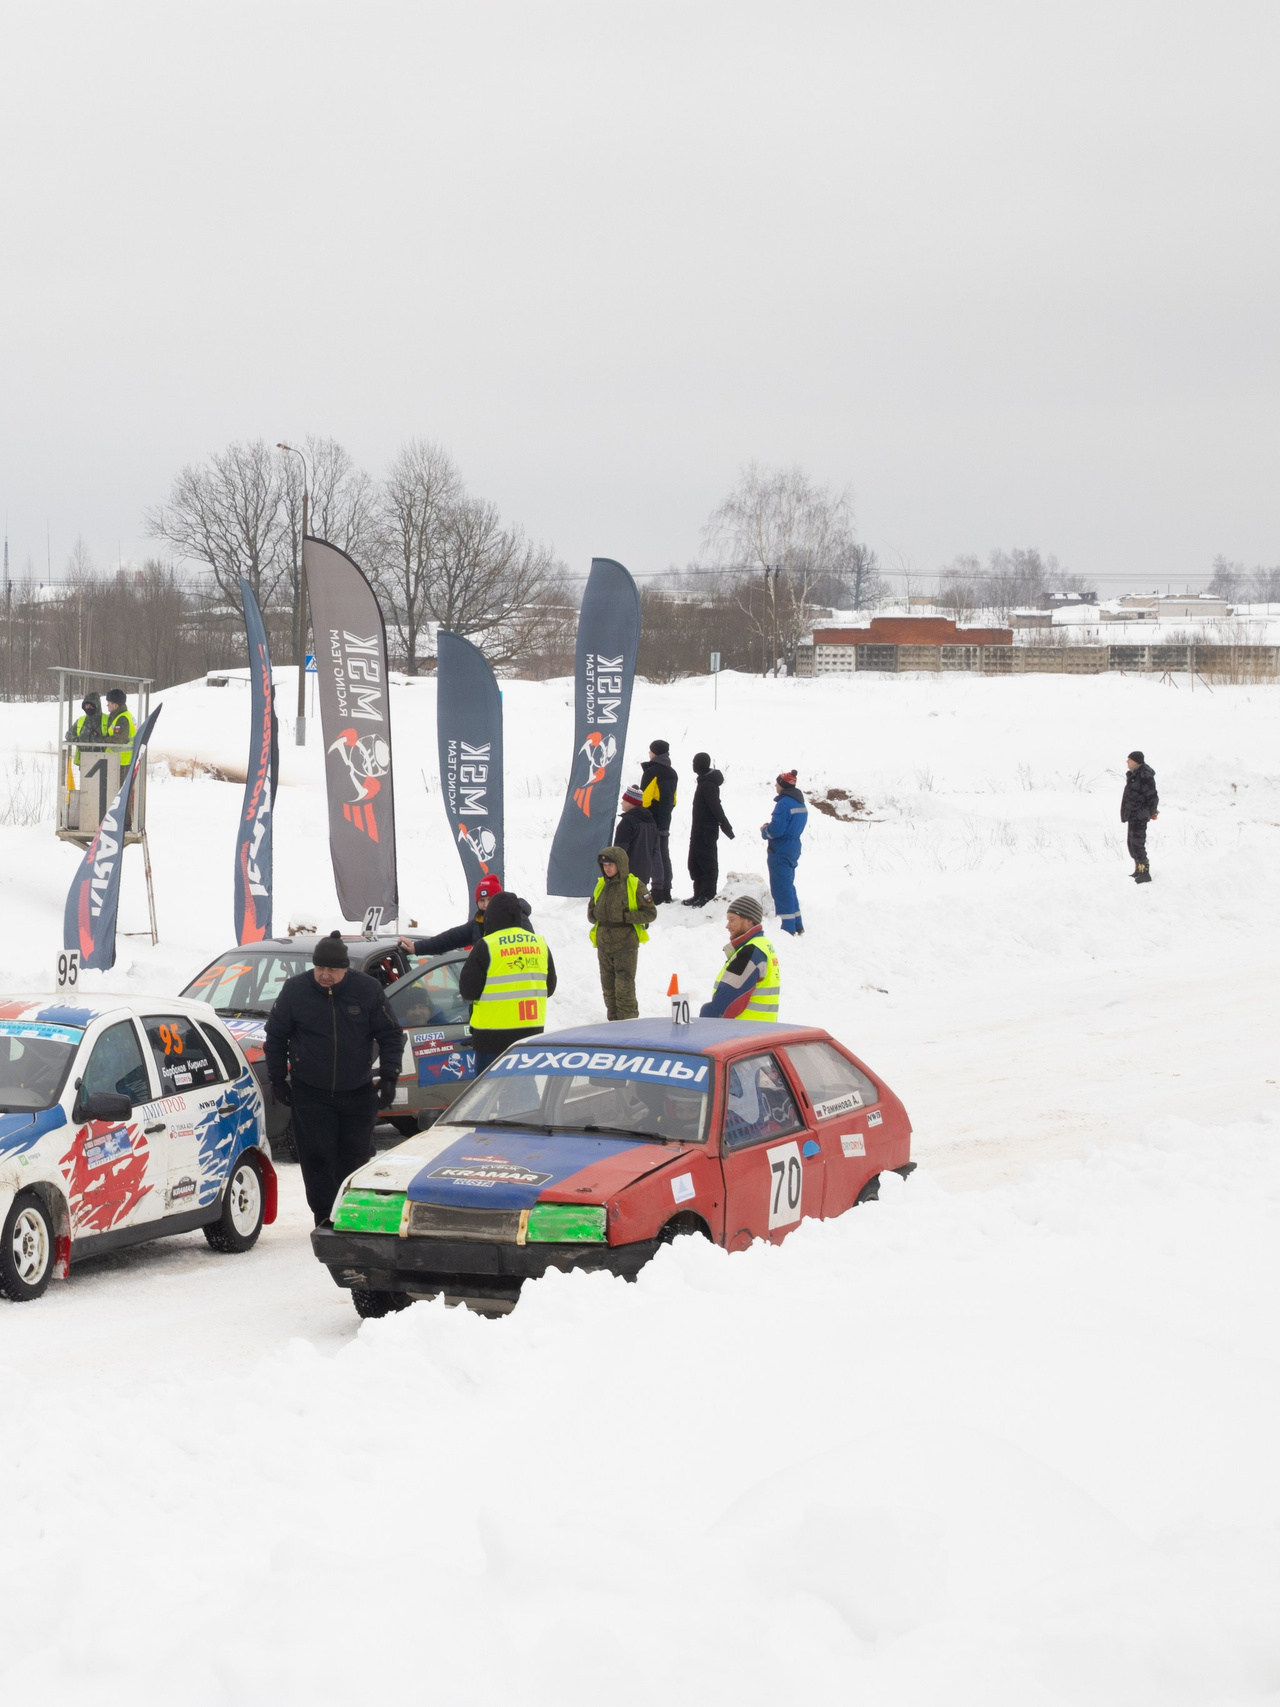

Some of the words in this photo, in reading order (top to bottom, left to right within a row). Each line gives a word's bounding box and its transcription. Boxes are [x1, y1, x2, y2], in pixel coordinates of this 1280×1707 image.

[365, 907, 382, 931] 27
[498, 933, 538, 946] RUSTA
[500, 946, 541, 958] МАРШАЛ
[58, 953, 78, 986] 95
[193, 966, 253, 987] 27
[518, 1000, 538, 1021] 10
[672, 1000, 690, 1024] 70
[160, 1023, 184, 1055] 95
[415, 1033, 444, 1041] RUSTA
[490, 1052, 709, 1082] ЛУХОВИЦЫ
[143, 1096, 186, 1123] ДМИТРОВ
[199, 1100, 216, 1109] NWB
[867, 1111, 881, 1122] NWB
[441, 1168, 539, 1182] KRAMAR
[771, 1156, 801, 1215] 70
